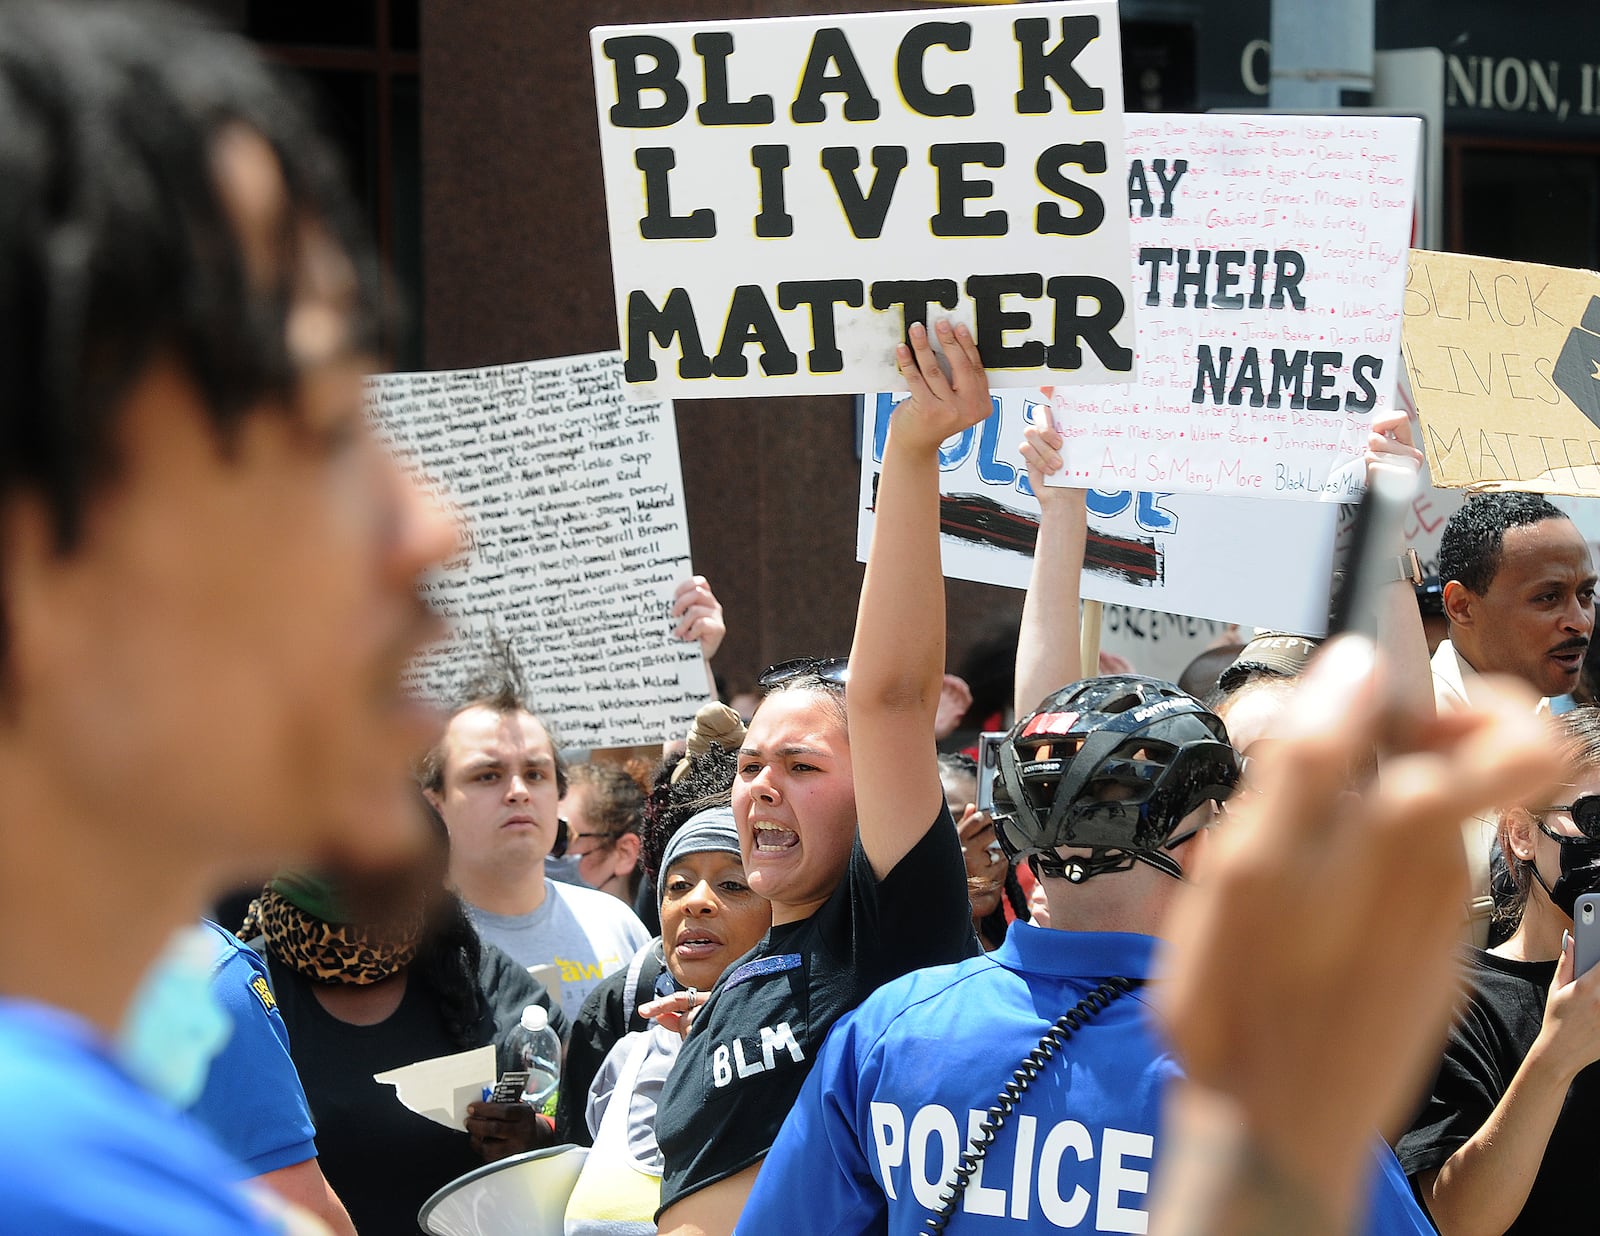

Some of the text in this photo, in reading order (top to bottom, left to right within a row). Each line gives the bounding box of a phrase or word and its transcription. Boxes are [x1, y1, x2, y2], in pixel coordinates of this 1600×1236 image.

[603, 14, 1104, 128] BLACK
[1447, 54, 1569, 122] NION,
[635, 140, 1107, 240] LIVES
[1128, 159, 1188, 218] AY
[1139, 247, 1306, 310] THEIR
[625, 272, 1132, 383] MATTER
[1191, 344, 1384, 414] NAMES
[1406, 342, 1560, 405] LIVES
[1099, 445, 1137, 479] And
[1169, 457, 1213, 491] Many
[1217, 459, 1263, 487] More
[1275, 463, 1304, 491] Black
[1337, 472, 1368, 496] Matte
[638, 523, 678, 537] Brown
[711, 1021, 806, 1089] BLM
[870, 1101, 1154, 1235] POLICE
